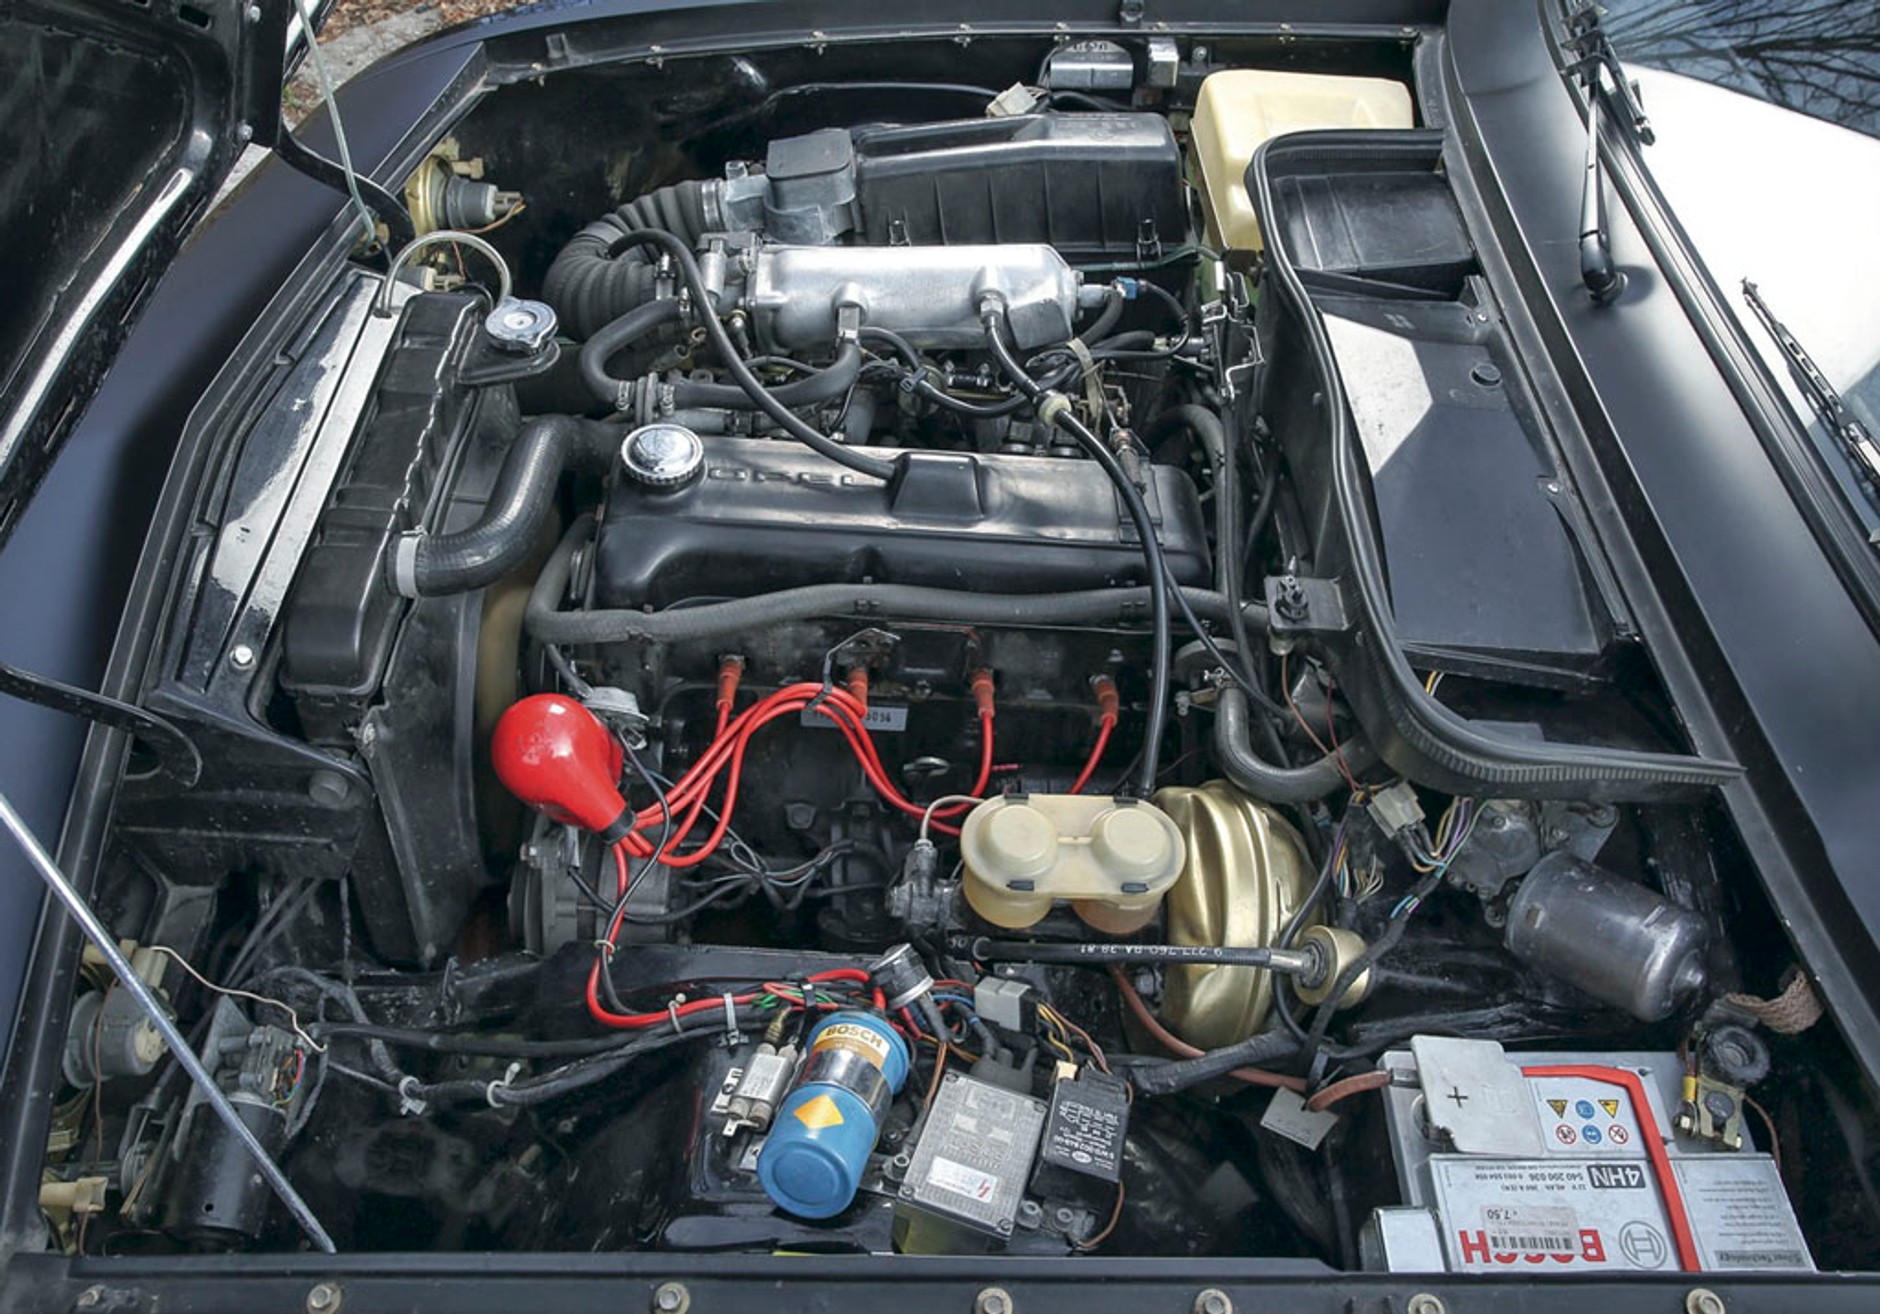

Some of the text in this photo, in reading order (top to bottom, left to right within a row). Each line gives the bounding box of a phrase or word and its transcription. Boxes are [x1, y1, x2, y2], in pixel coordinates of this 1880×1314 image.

[708, 466, 888, 488] OPEL
[825, 1024, 883, 1048] BOSCH
[1592, 1168, 1642, 1187] 4HN
[1487, 1208, 1511, 1220] 7,50
